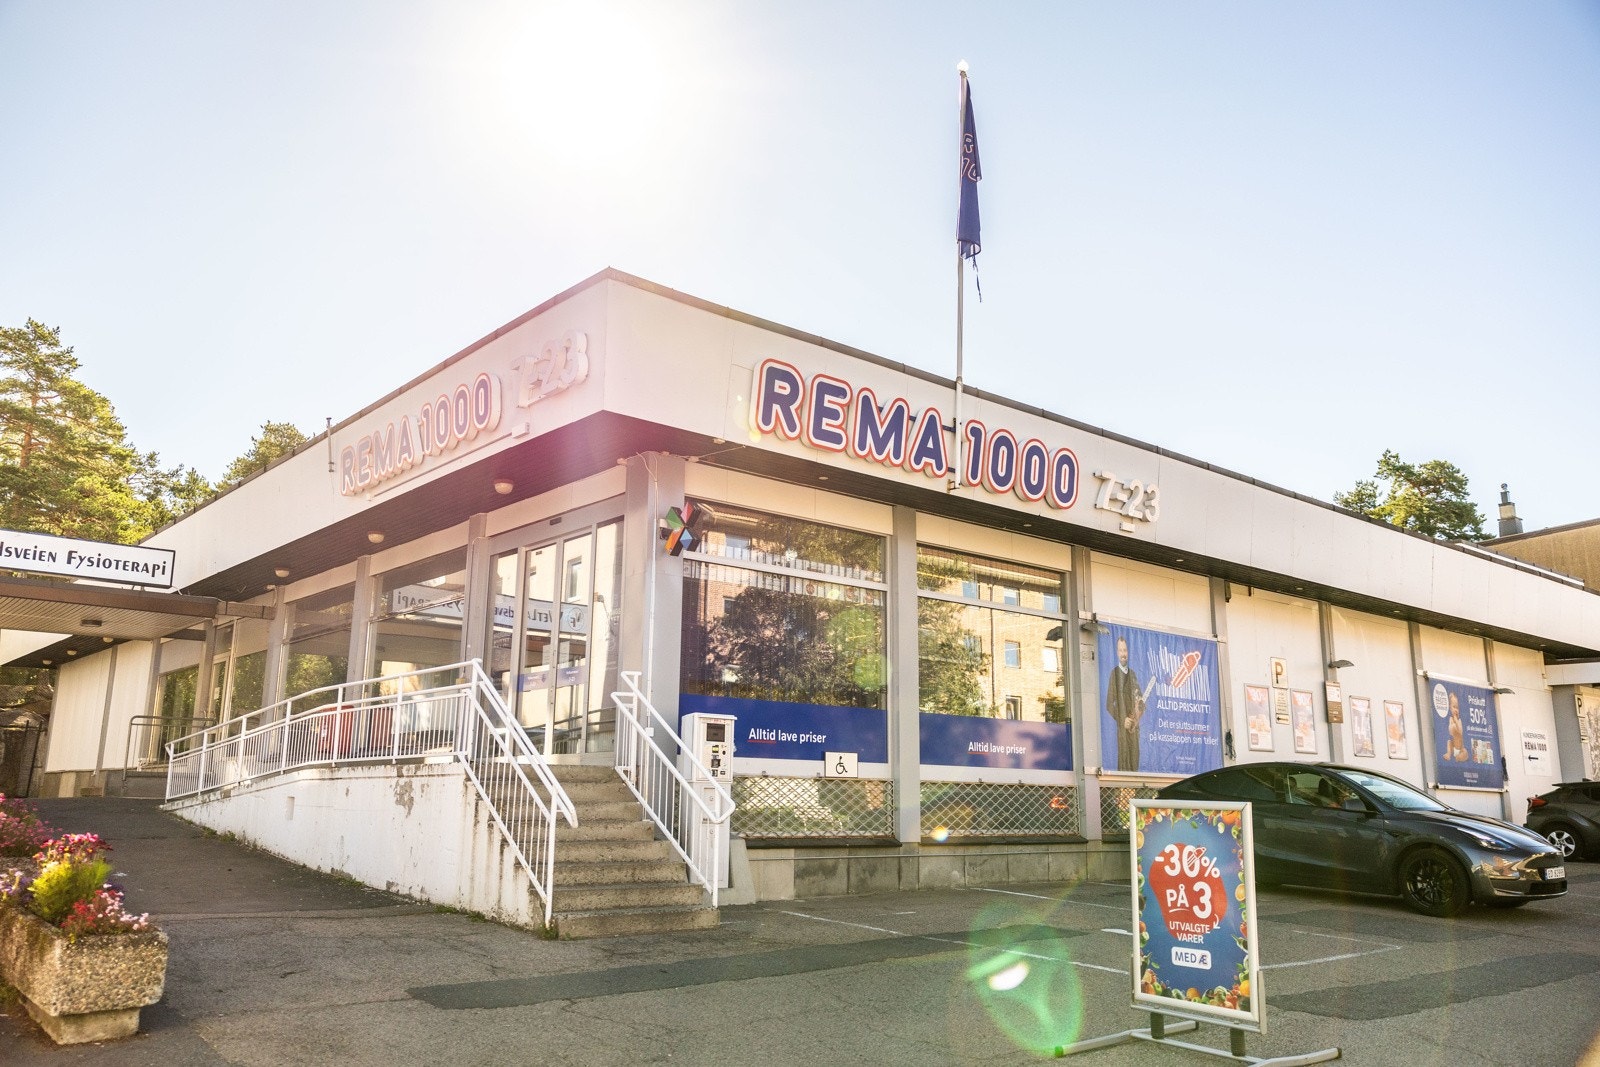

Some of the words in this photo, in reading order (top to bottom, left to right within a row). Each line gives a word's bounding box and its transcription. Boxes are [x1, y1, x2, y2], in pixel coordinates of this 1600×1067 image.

[511, 330, 589, 408] 7-23
[340, 415, 416, 497] REMA
[420, 372, 498, 457] 1000
[756, 358, 949, 479] REMA
[965, 420, 1080, 510] 1000
[1094, 471, 1161, 522] 7-23
[1274, 662, 1284, 684] P
[1157, 699, 1179, 711] ALLTID
[1158, 718, 1169, 729] Det
[1469, 707, 1488, 725] 50%
[748, 728, 776, 741] Alltid
[778, 730, 797, 743] lave
[799, 732, 827, 745] priser
[1149, 731, 1157, 743] på
[968, 741, 989, 752] Alltid
[989, 743, 1004, 754] lave
[1005, 745, 1027, 756] priser
[1524, 741, 1537, 750] REMA
[1155, 843, 1221, 879] -30%
[1166, 884, 1189, 908] PÅ
[1192, 881, 1212, 919] 3
[1169, 921, 1211, 934] UTVALGTE
[1176, 932, 1204, 944] VARER
[1174, 951, 1197, 963] MED
